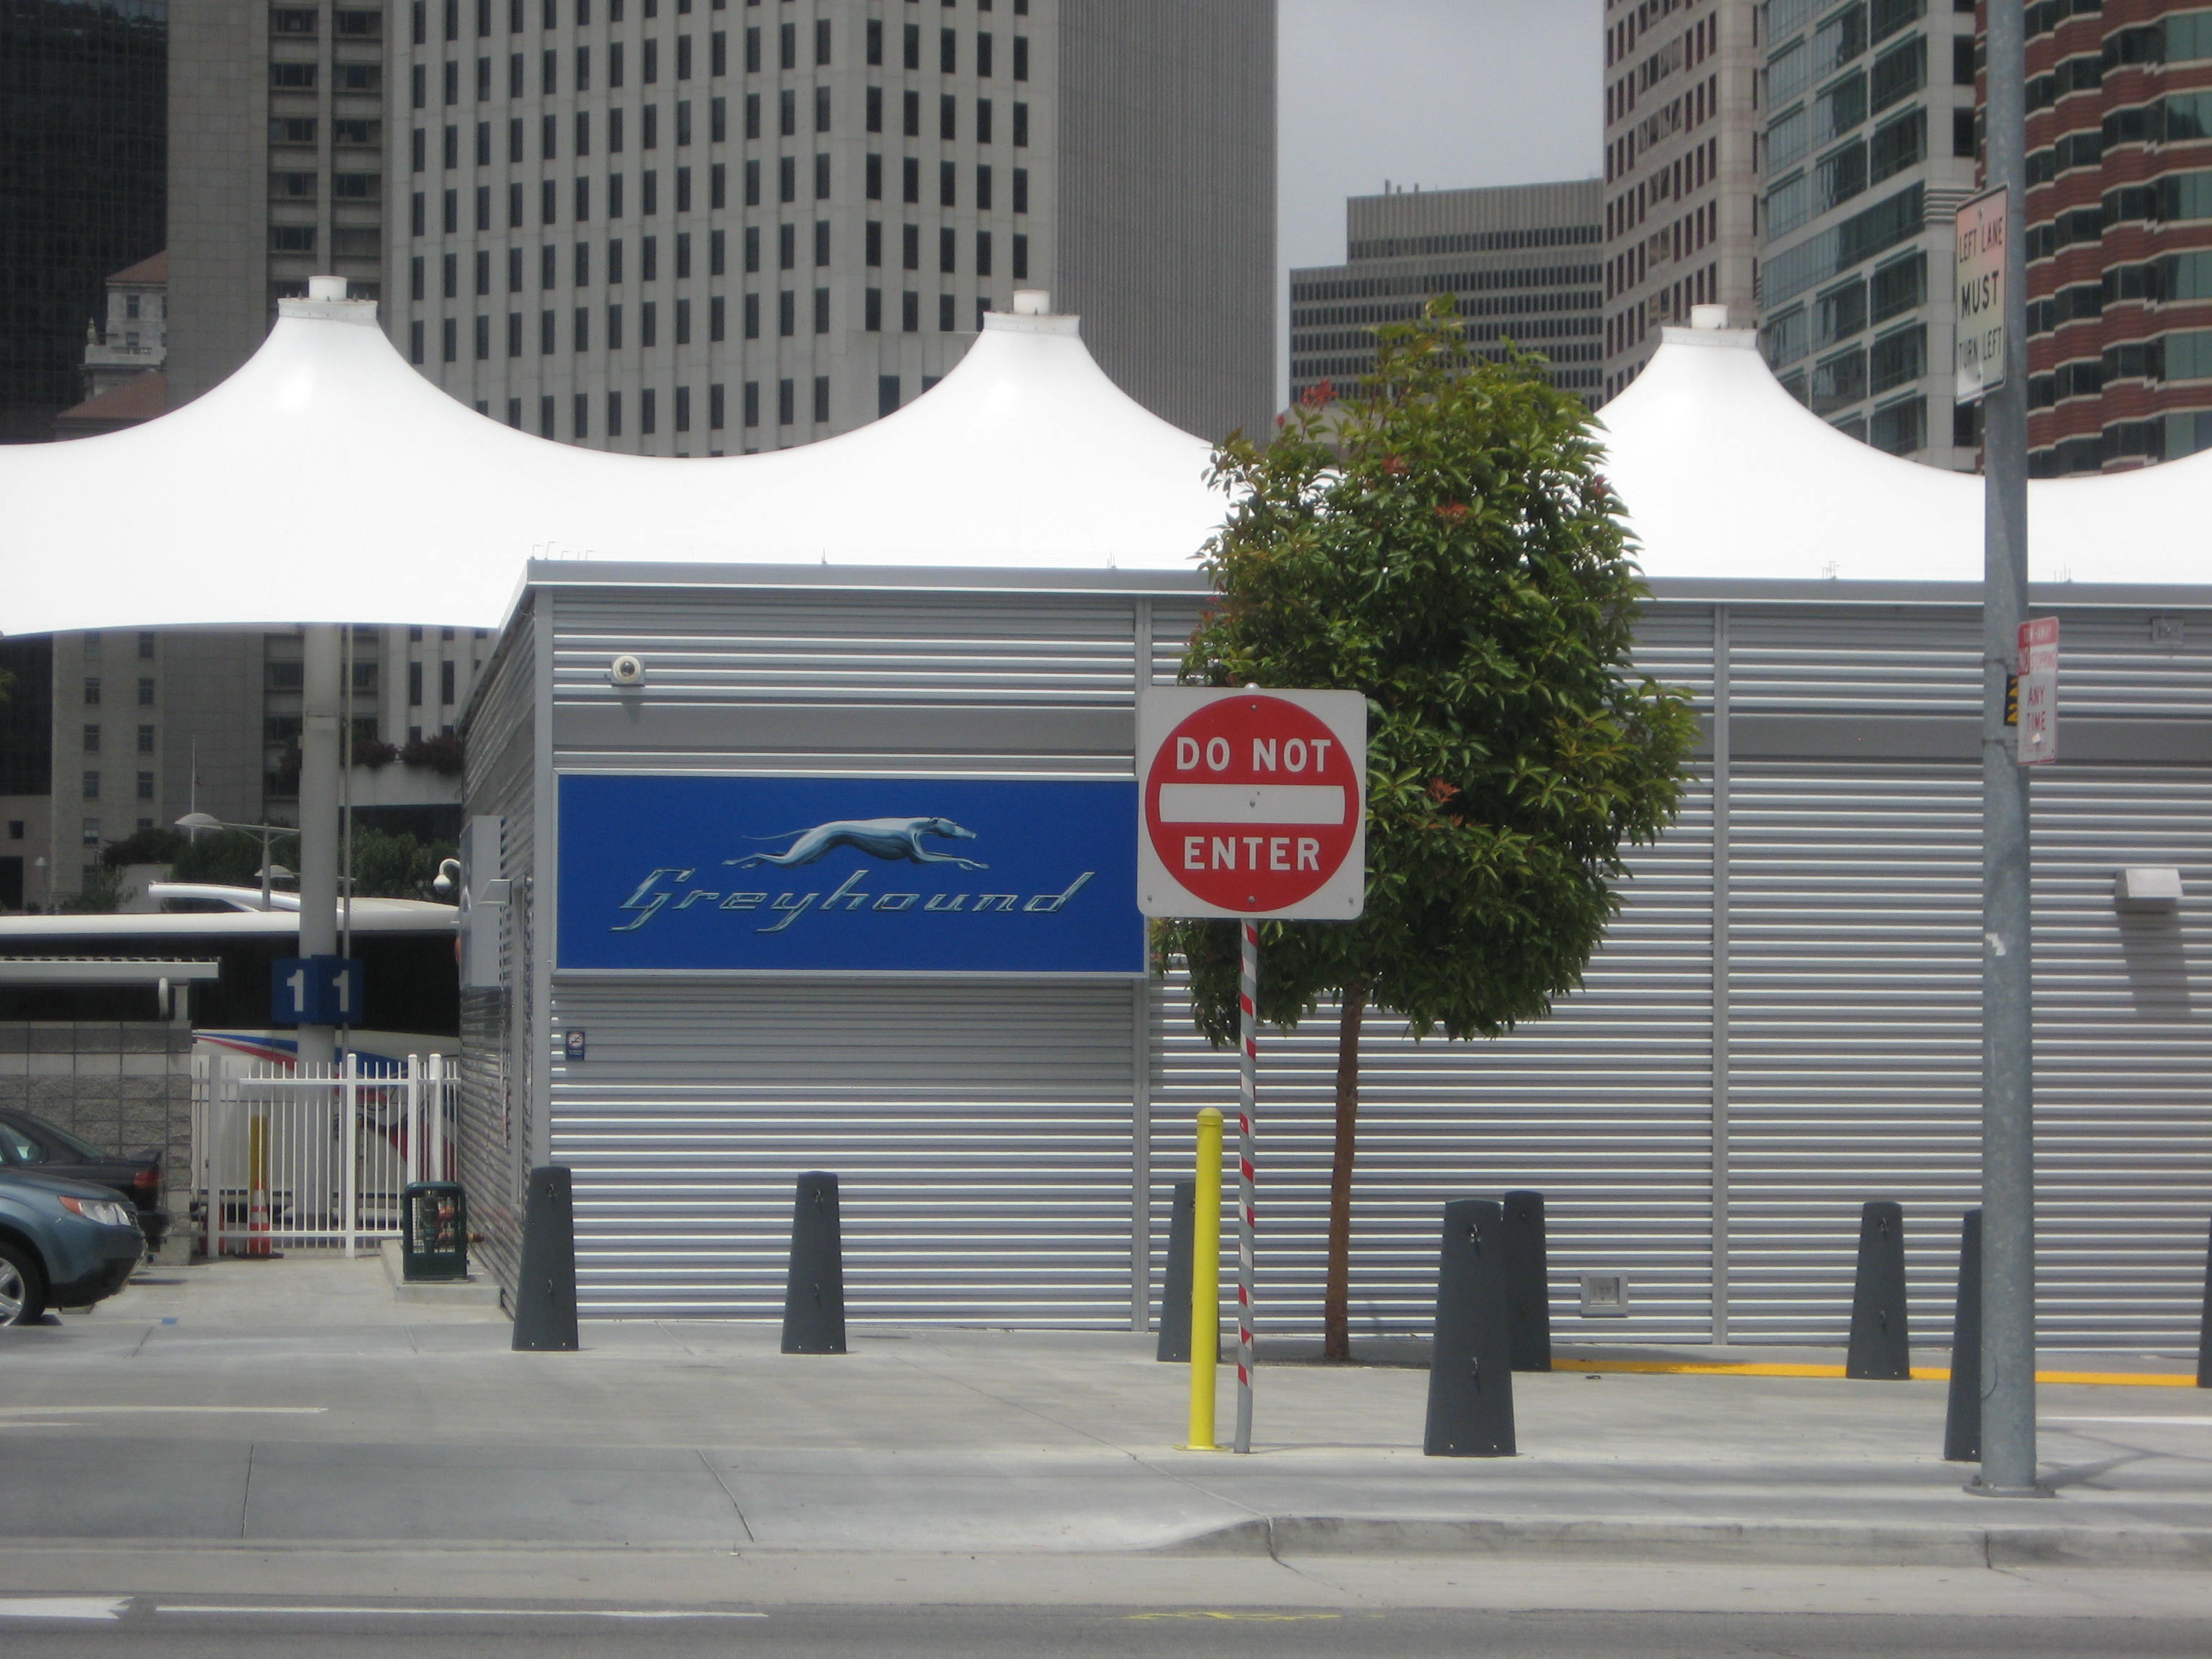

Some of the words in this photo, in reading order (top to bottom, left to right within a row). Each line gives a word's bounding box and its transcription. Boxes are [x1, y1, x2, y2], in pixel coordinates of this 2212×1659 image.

[1959, 228, 1977, 263] LEFT
[1982, 216, 2004, 253] LANE
[1961, 269, 2000, 319] MUST
[1959, 336, 1979, 369] TURN
[1982, 326, 2002, 361] LEFT
[2027, 685, 2045, 706] ANY
[2026, 711, 2046, 731] TIME
[1176, 737, 1231, 772] DO
[1252, 738, 1331, 773] NOT
[1184, 836, 1320, 871] ENTER
[608, 868, 1096, 933] Greyhound
[287, 969, 304, 1012] 1
[333, 970, 349, 1012] 1
